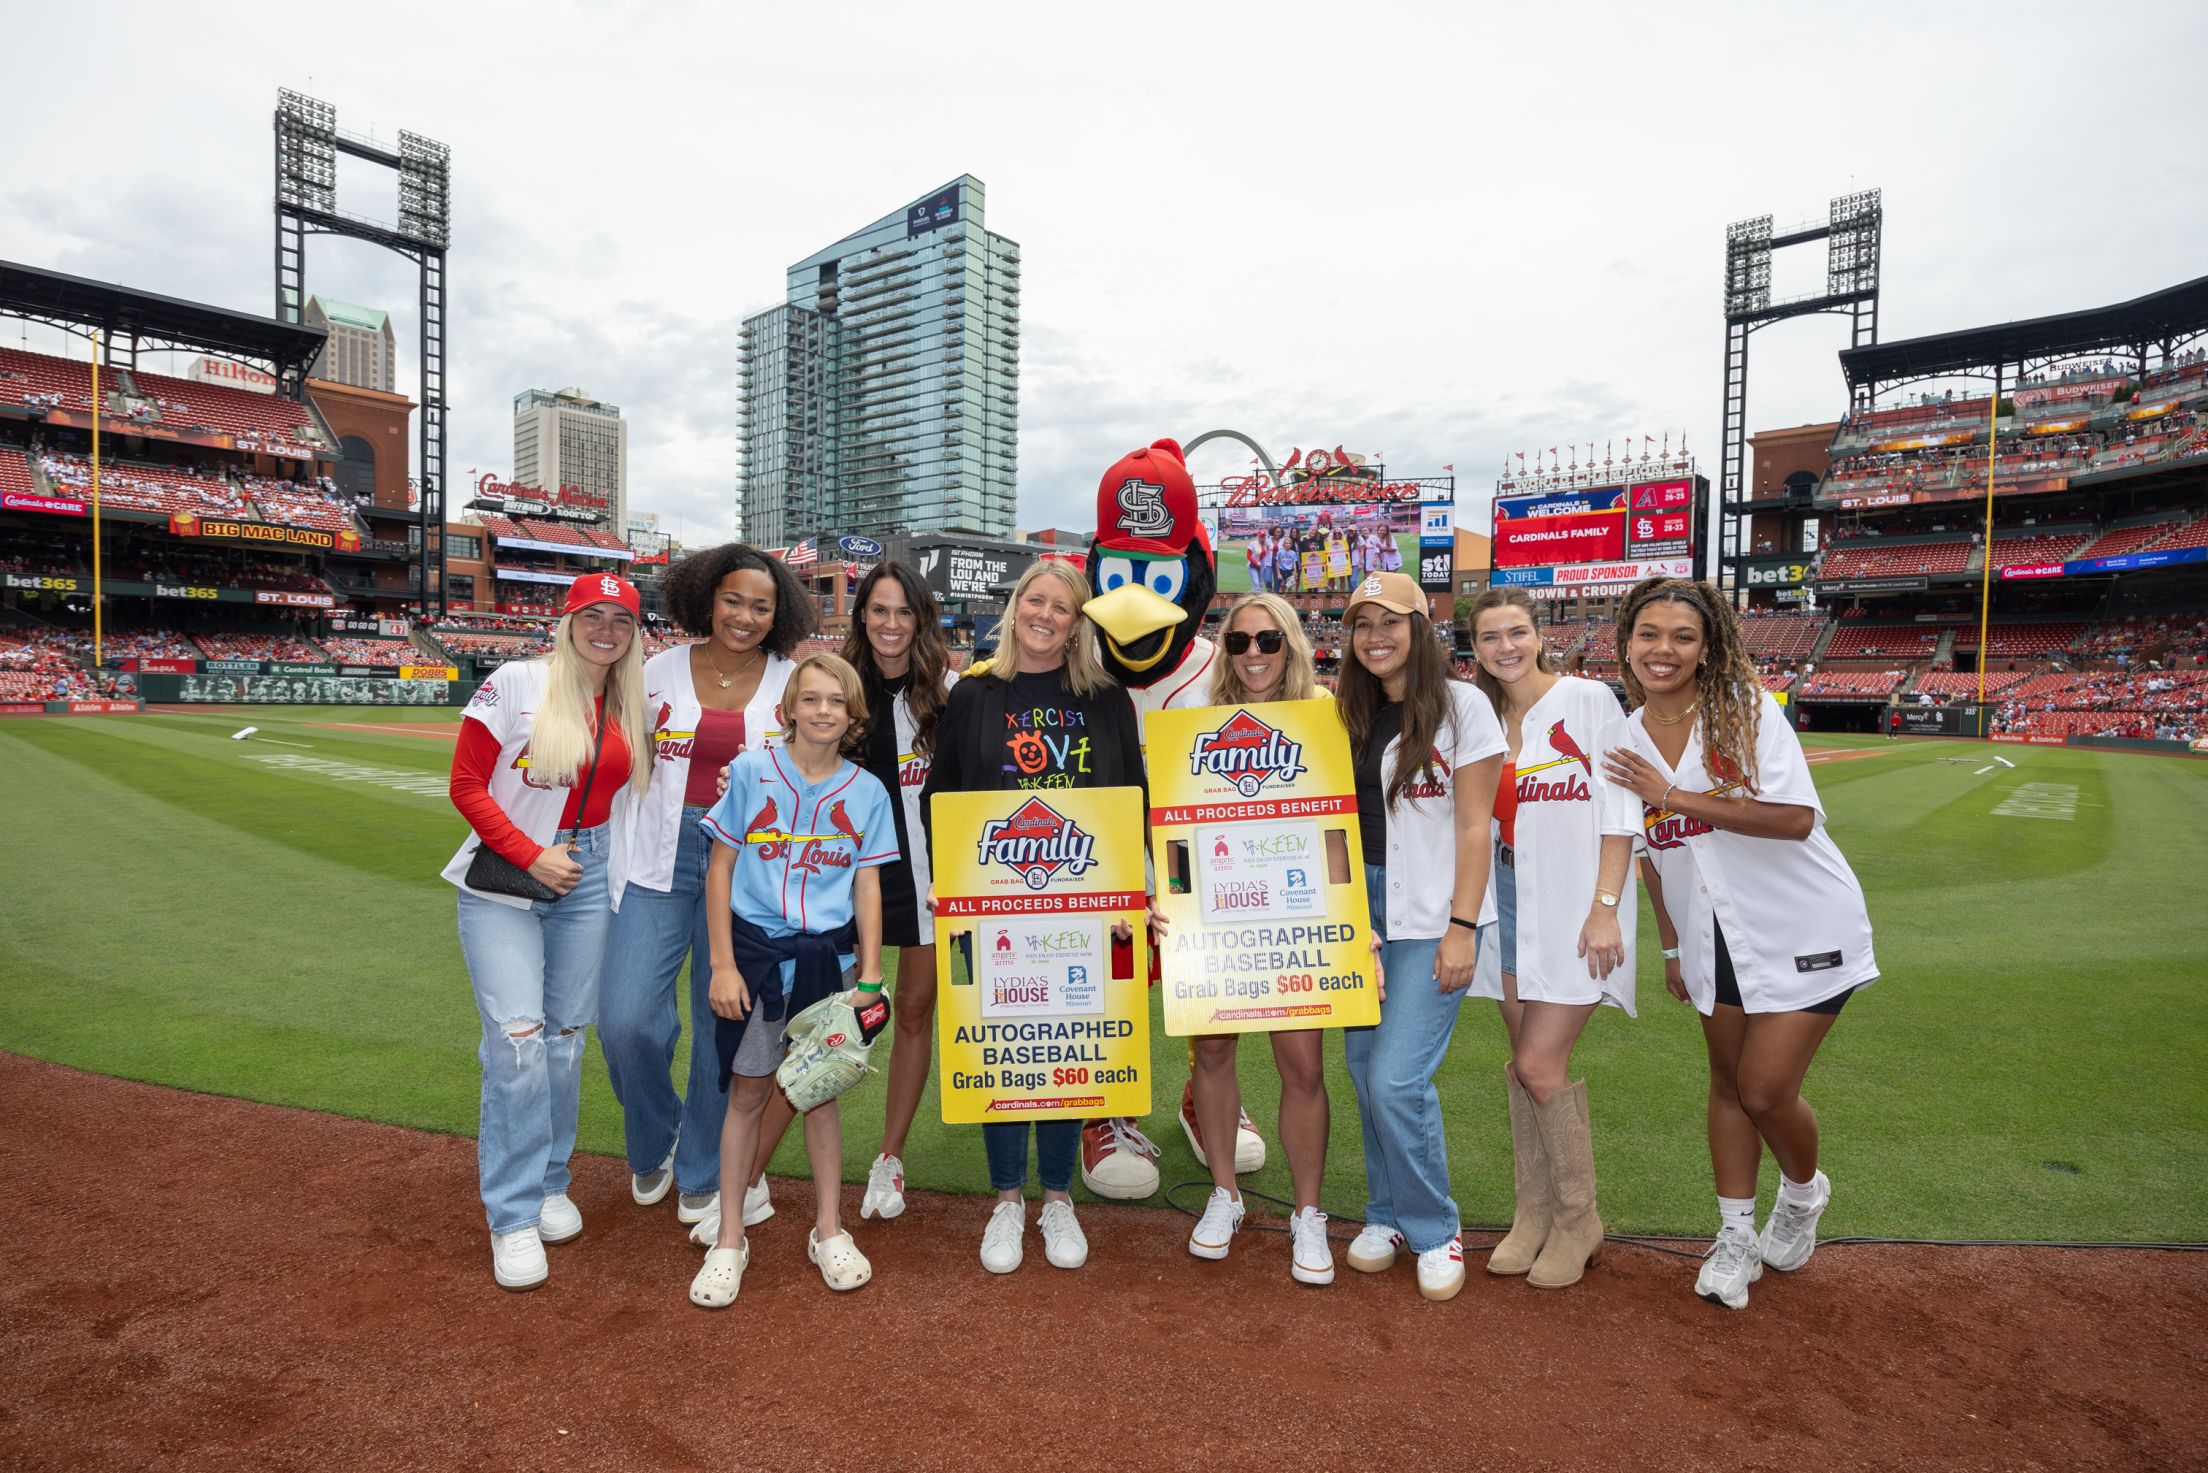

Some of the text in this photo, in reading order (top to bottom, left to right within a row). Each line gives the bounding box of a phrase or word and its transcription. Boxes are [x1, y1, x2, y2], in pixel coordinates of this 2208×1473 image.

[203, 357, 277, 385] Hilton
[2057, 381, 2121, 396] BUDWEISER
[236, 440, 312, 459] ST. LOUIS
[1514, 463, 1674, 490] WORLD CHAMPIONS
[479, 473, 609, 509] Cardinals Nation
[1220, 474, 1420, 508] Budweiser
[5, 495, 83, 512] Cardinals CARE
[503, 500, 544, 514] HOFFMANN
[1537, 500, 1580, 510] CARDINALS
[1841, 494, 1910, 508] ST. LOUIS
[556, 508, 596, 520] ROOFTOP
[1527, 504, 1591, 518] WELCOME
[203, 521, 333, 548] BIG MAC LAND
[1509, 526, 1610, 543] CARDINALS FAMILY
[848, 538, 874, 553] Ford
[950, 557, 1007, 573] FROM THE
[1422, 553, 1451, 572] stl
[950, 567, 999, 582] LOU AND
[1505, 570, 1540, 583] STIFEL
[1556, 564, 1638, 582] PROUD SPONSOR
[1747, 564, 1809, 584] bet3
[2004, 566, 2061, 577] Cardinals CARE
[6, 575, 77, 591] bet365
[950, 579, 986, 593] WE'RE
[1822, 584, 1840, 592] Mercy
[156, 585, 218, 599] bet365
[257, 592, 333, 606] ST. LOUIS
[1569, 586, 1578, 598] &
[368, 622, 378, 630] GO
[412, 668, 448, 676] DOBBS
[1906, 713, 1925, 722] Mercy
[1224, 726, 1265, 741] Cardinals
[1190, 729, 1308, 782] Family
[1262, 782, 1296, 790] FUNDRAISER
[1164, 799, 1343, 822] ALL PROCEEDS BENEFIT
[1014, 815, 1058, 831] Cardinals
[758, 828, 852, 875] St. Louis
[977, 819, 1099, 876] Family
[1257, 833, 1307, 856] KEEN
[990, 878, 1009, 886] GRAB
[1050, 876, 1085, 884] FUNDRAISER
[1214, 880, 1269, 893] LYDIA'S
[1279, 888, 1317, 897] Covenant
[1286, 896, 1311, 904] House
[948, 895, 1132, 913] ALL PROCEEDS BENEFIT
[1213, 892, 1270, 910] HOUSE
[1039, 930, 1091, 952] KEEN
[1175, 923, 1355, 952] AUTOGRAPHED
[1204, 949, 1331, 974] BASEBALL
[994, 975, 1049, 988] LYDIA'S
[1175, 971, 1364, 1000] Grab Bags $60 each
[992, 987, 1049, 1005] HOUSE
[1059, 985, 1097, 994] Covenant
[1065, 992, 1091, 1000] House
[1219, 1006, 1332, 1021] cardinals.com/grabbags
[954, 1020, 1133, 1044] AUTOGRAPHED
[983, 1043, 1108, 1066] BASEBALL
[952, 1065, 1138, 1091] Grab Bags $60 each
[995, 1096, 1105, 1110] cardinals.com/grabbags
